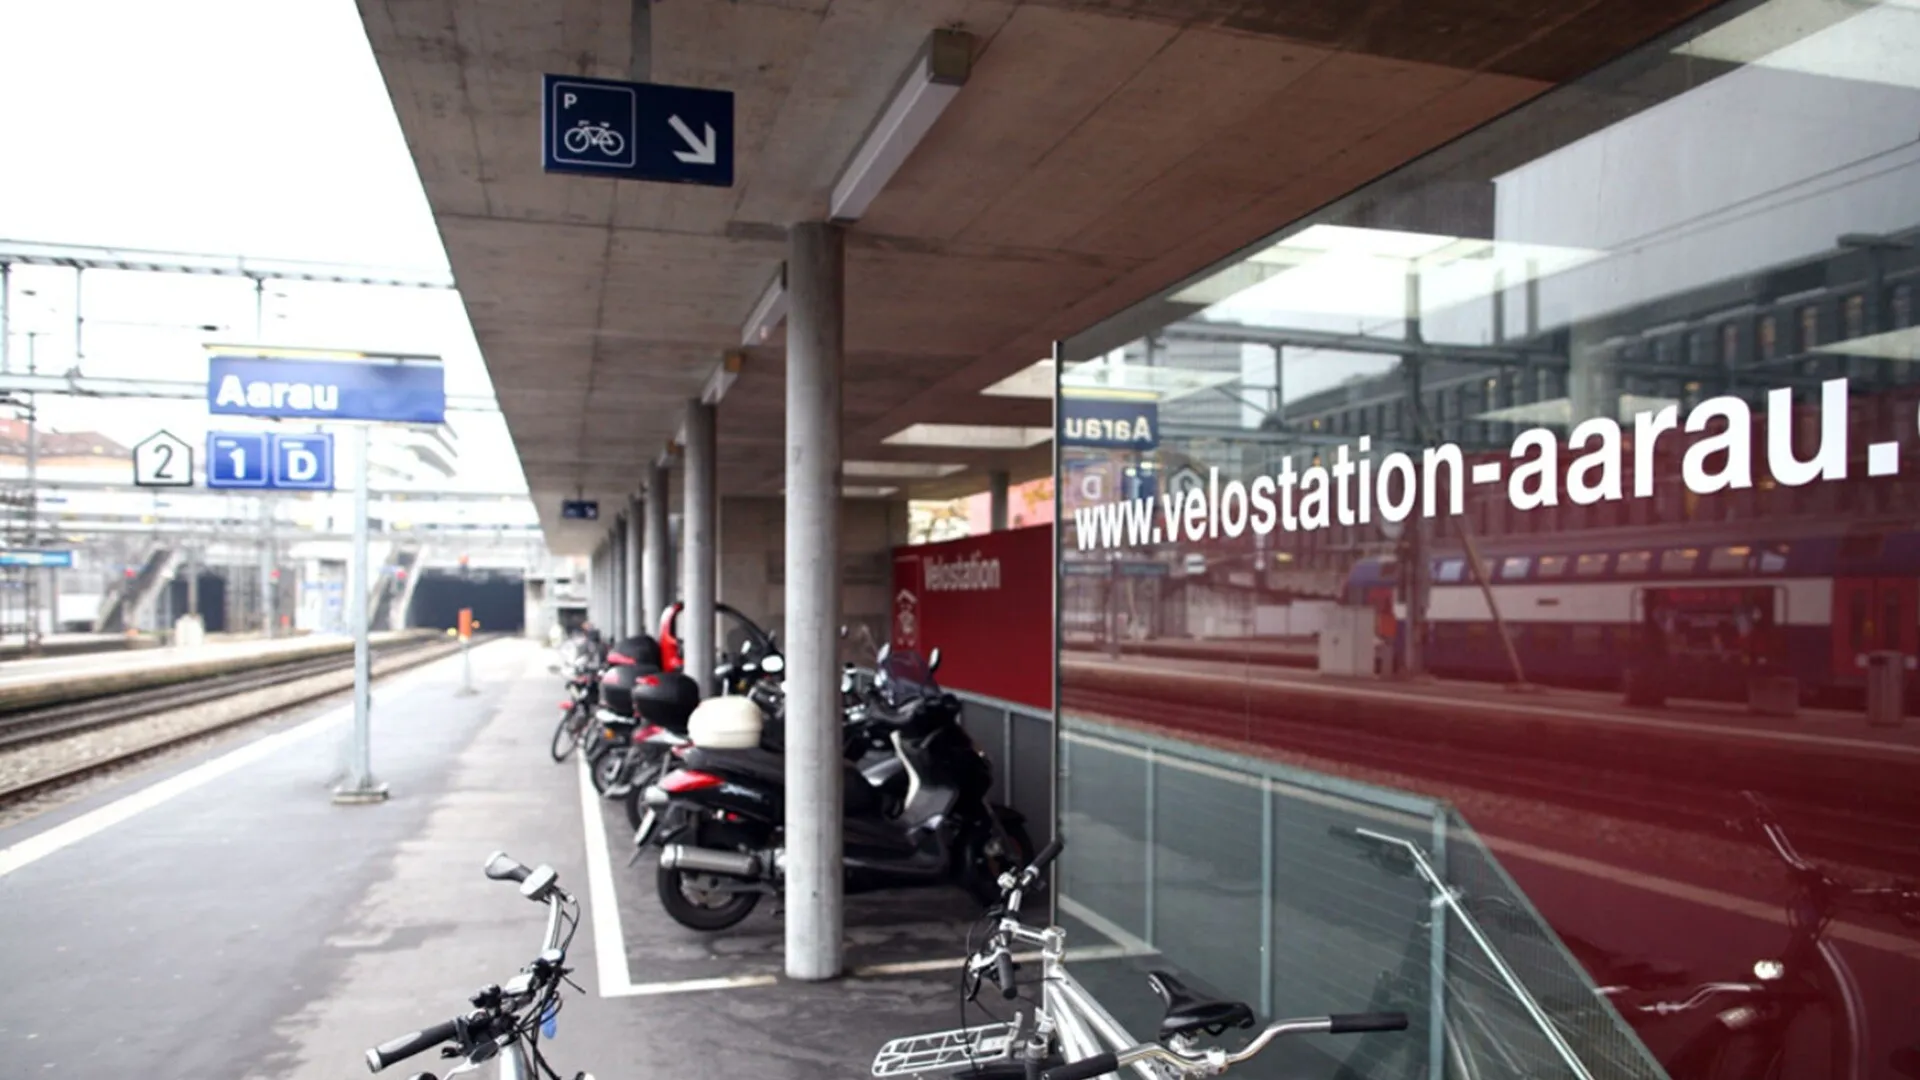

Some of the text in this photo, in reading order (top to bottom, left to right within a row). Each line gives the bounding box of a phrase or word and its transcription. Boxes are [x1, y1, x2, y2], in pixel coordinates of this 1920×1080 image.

[564, 93, 578, 109] P
[216, 374, 339, 410] Aarau
[153, 443, 174, 479] 2
[228, 447, 318, 480] 1 D
[1073, 379, 1920, 550] www.velostation-aarau.
[923, 551, 1001, 591] Velostation
